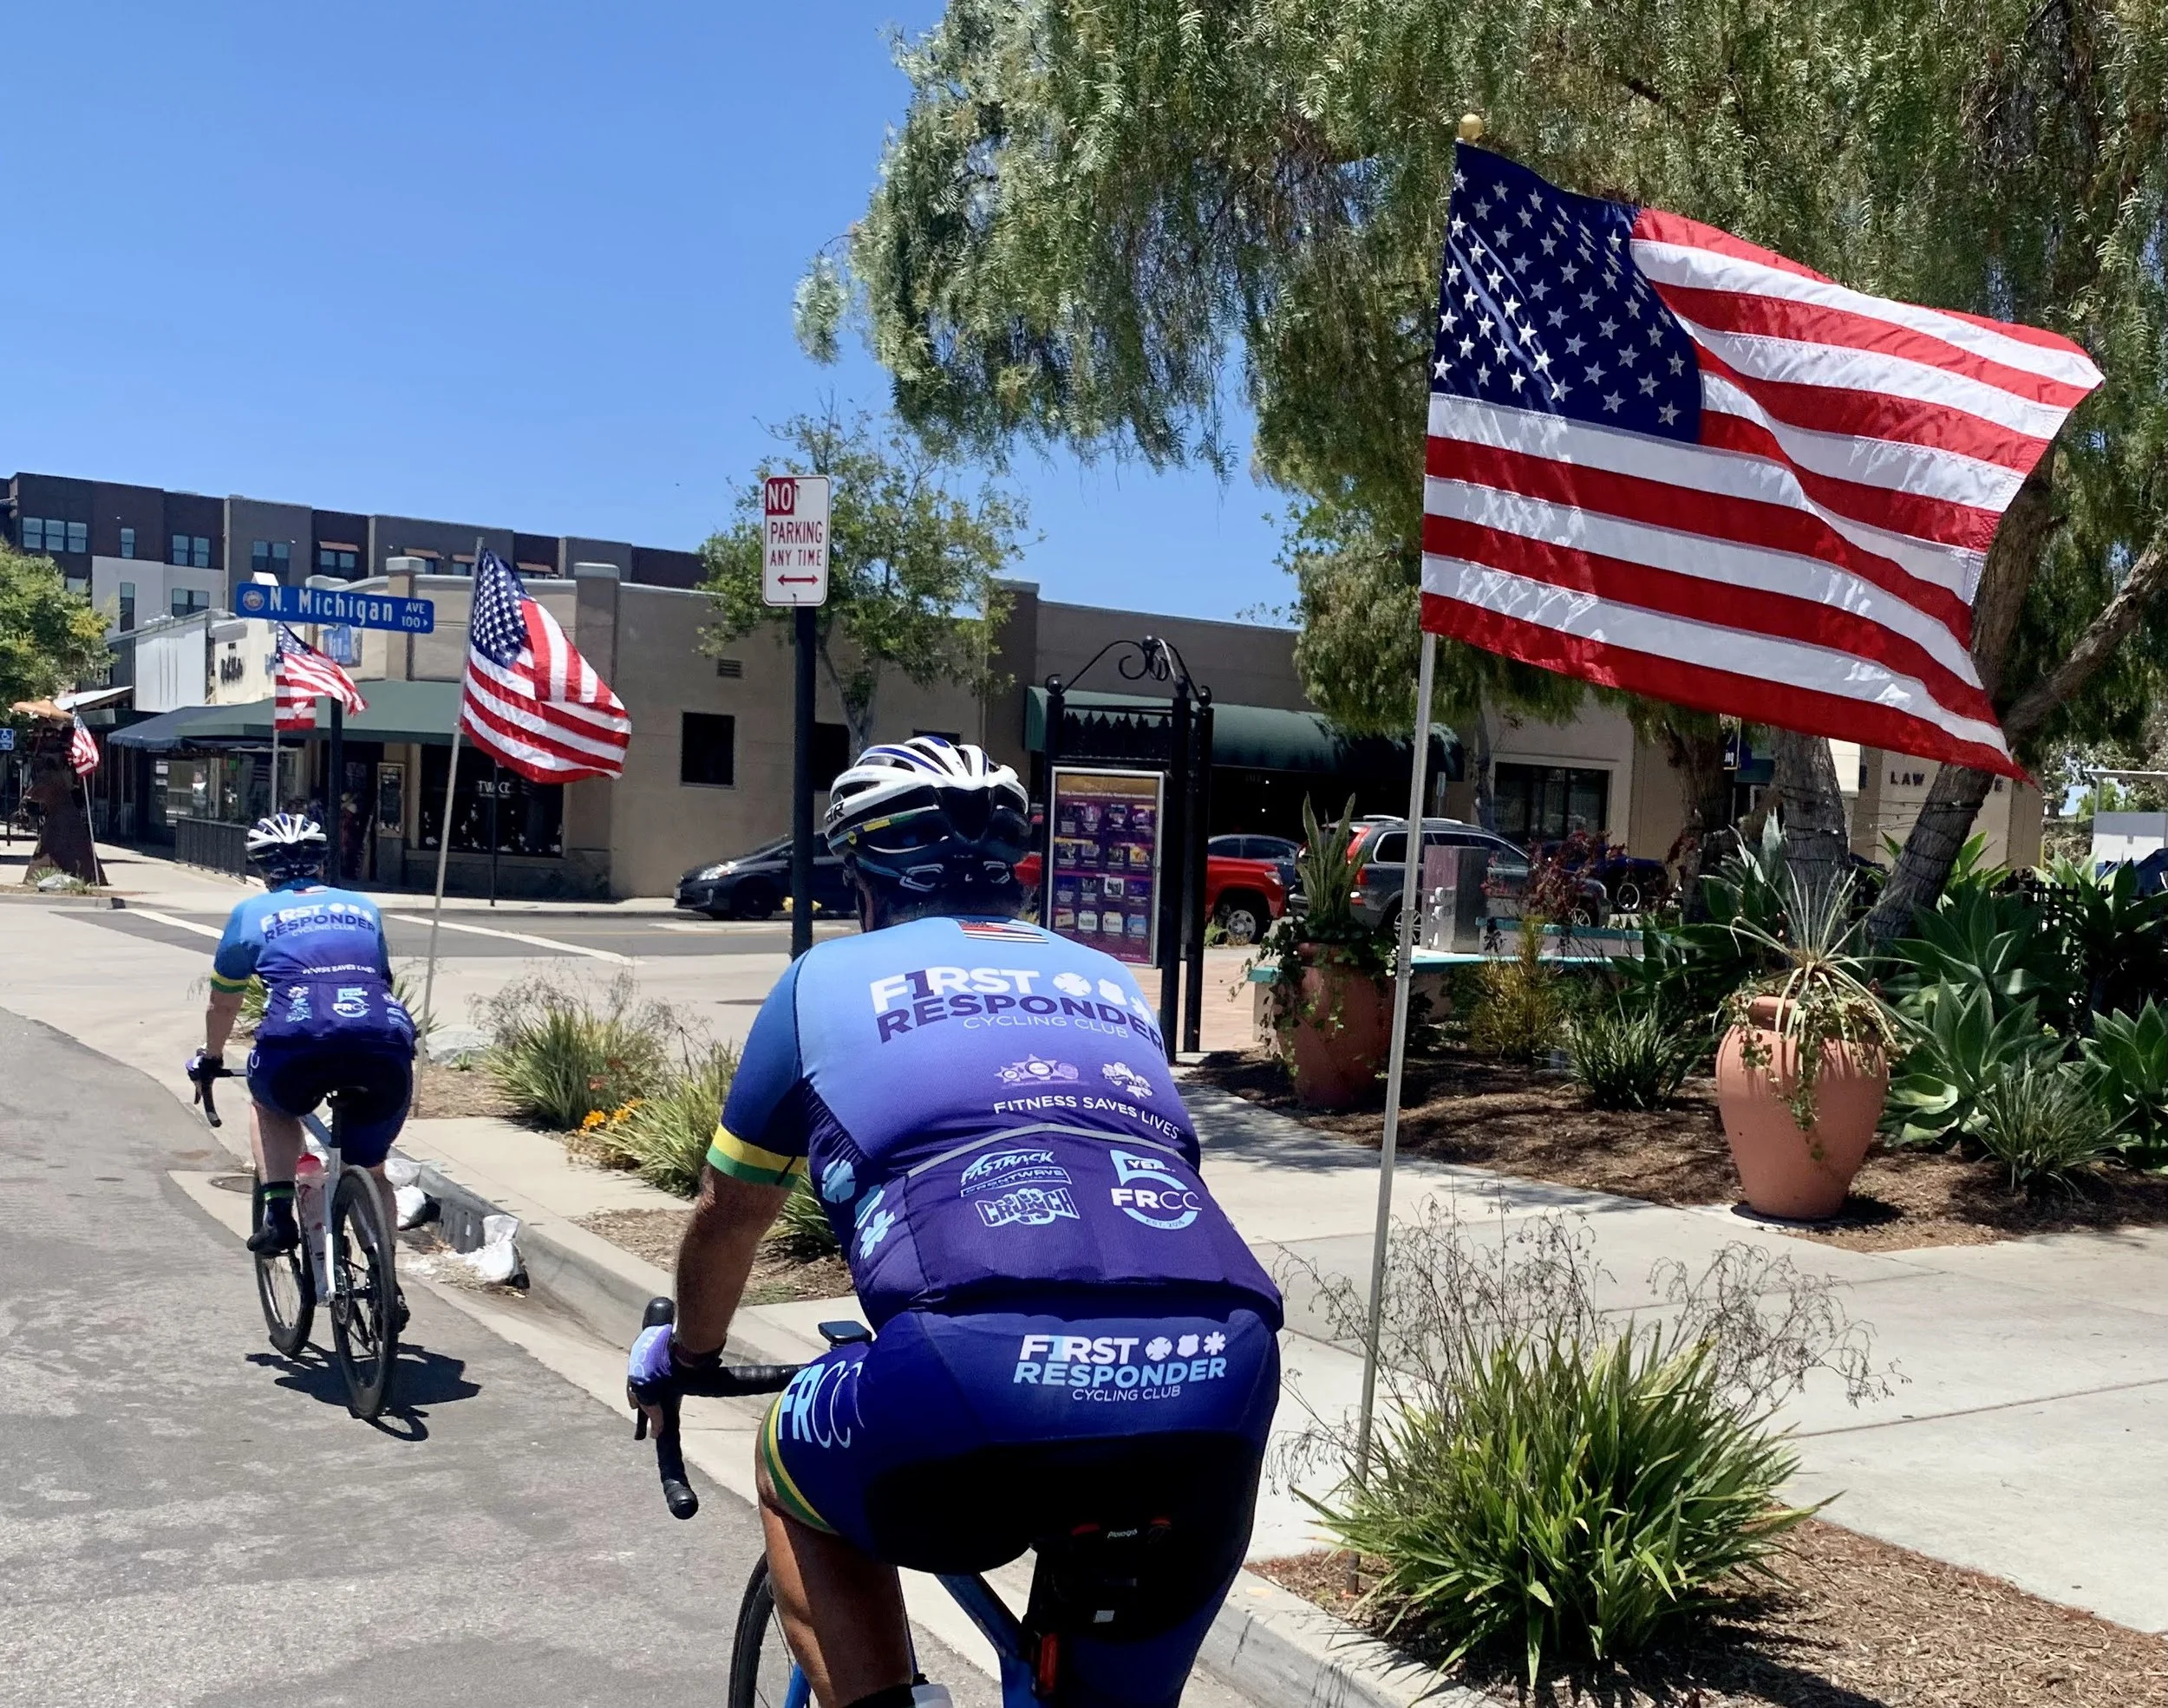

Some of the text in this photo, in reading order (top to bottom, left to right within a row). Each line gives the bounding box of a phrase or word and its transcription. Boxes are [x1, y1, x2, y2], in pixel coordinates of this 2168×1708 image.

[767, 483, 792, 511] NO
[770, 521, 823, 544] PARKING
[770, 549, 822, 566] ANY TIME
[270, 586, 392, 626] N. Michigan
[405, 602, 425, 614] AVE
[402, 616, 420, 628] 100
[478, 780, 511, 793] TWCE
[1890, 771, 1925, 786] LAW
[264, 915, 375, 943] RESPONDER
[333, 1002, 371, 1011] FRCC
[877, 994, 1165, 1058] RESPONDER
[963, 1015, 1129, 1039] CYCLING CLUB
[993, 1095, 1179, 1139] FITNESS SAVES LIVES
[976, 1189, 1078, 1227] CRUNCH
[1111, 1188, 1202, 1210] FRCC
[1013, 1357, 1227, 1388] RESPONDER
[777, 1360, 864, 1449] FRCC
[1073, 1385, 1181, 1402] CYCLING CLUB
